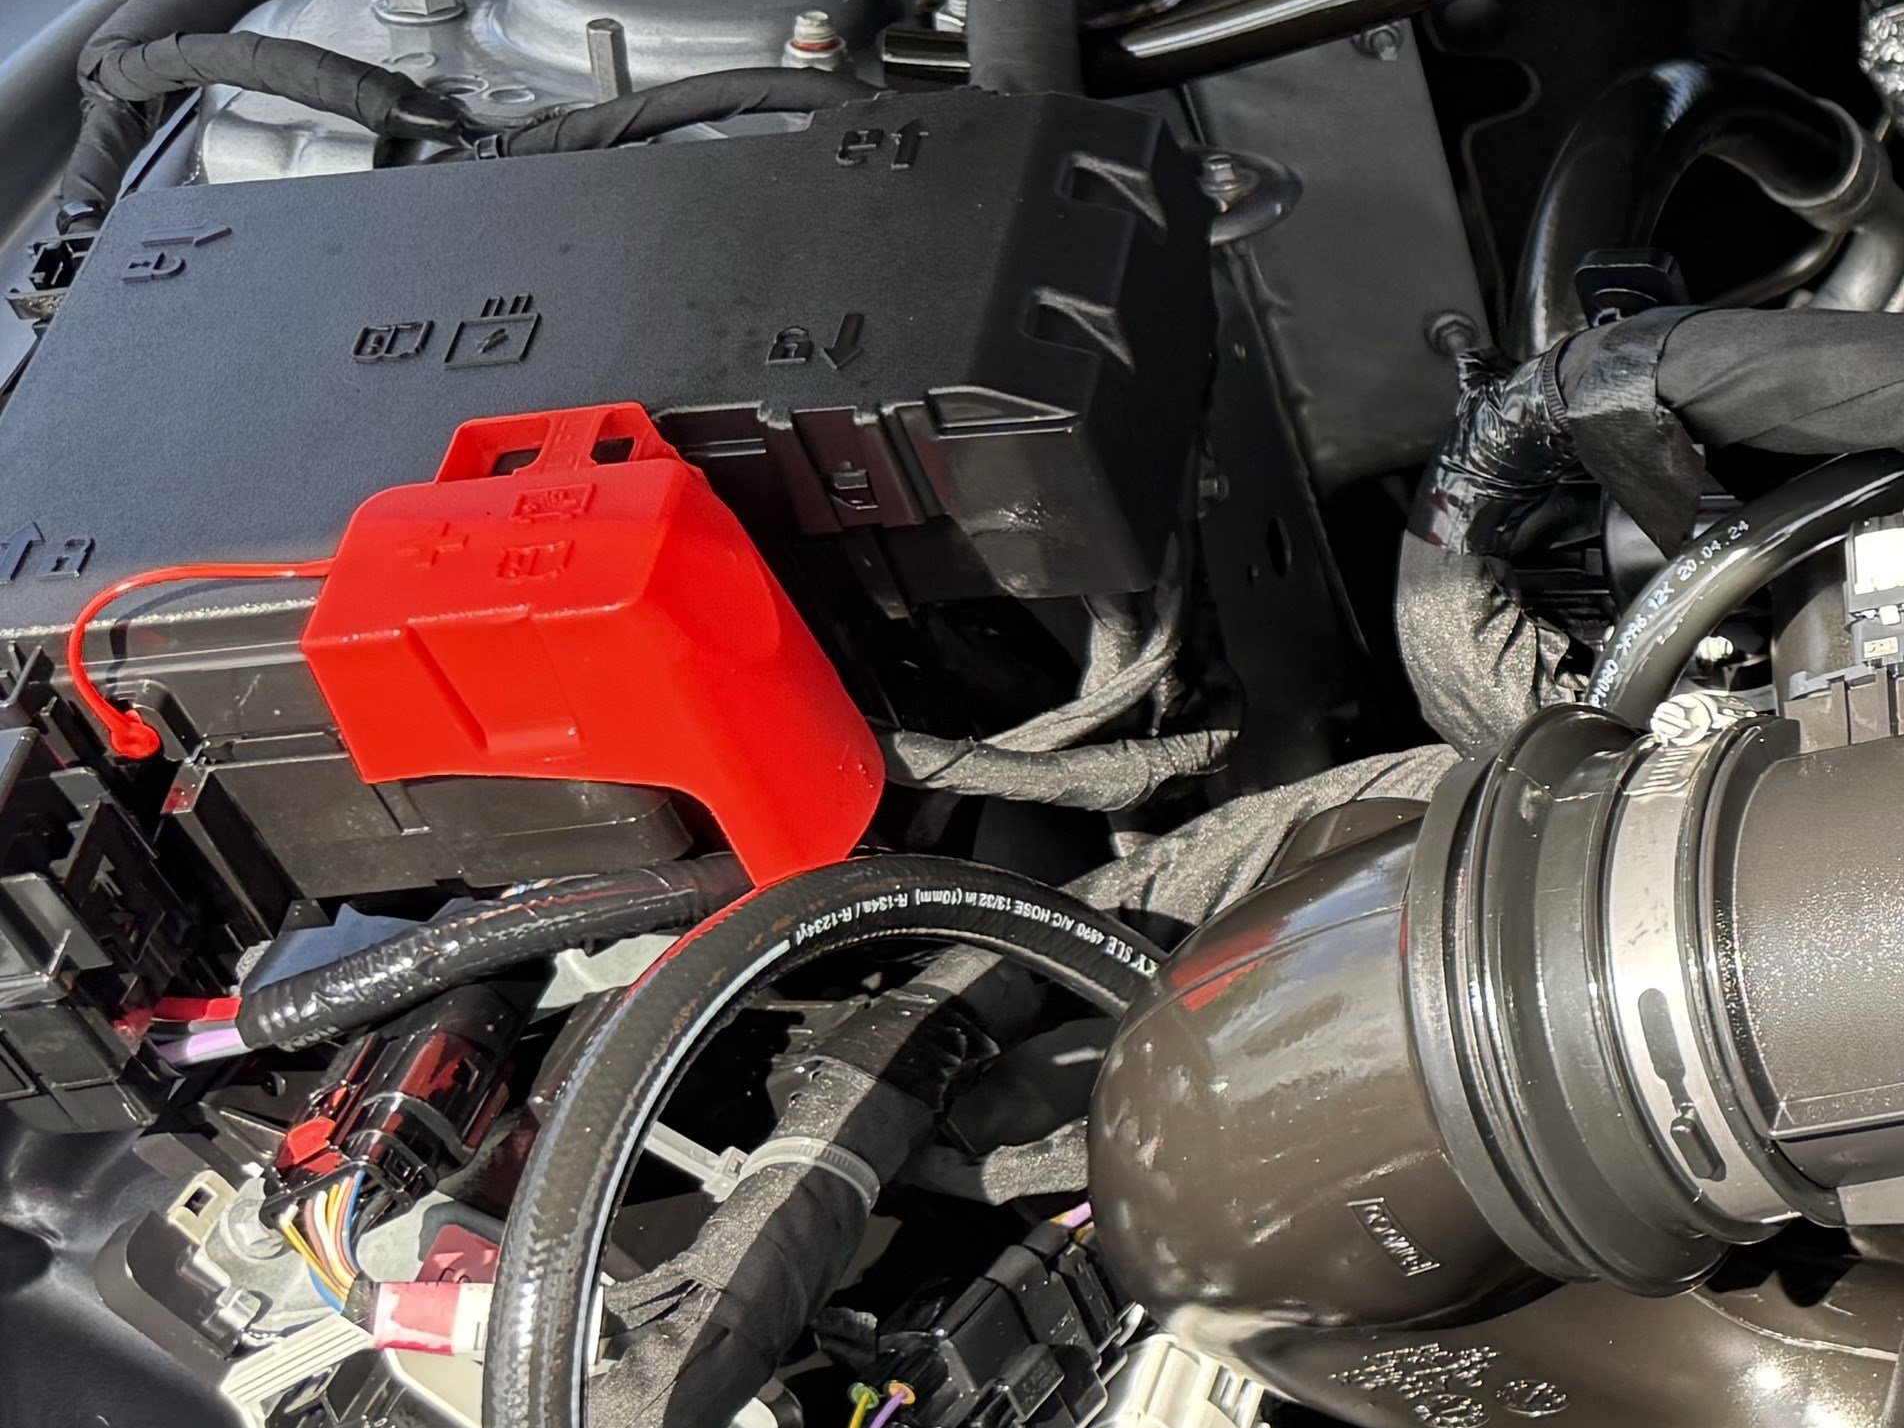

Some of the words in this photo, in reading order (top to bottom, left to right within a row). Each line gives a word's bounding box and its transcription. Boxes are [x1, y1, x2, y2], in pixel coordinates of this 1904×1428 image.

[1677, 519, 1750, 581] 20.04.24
[864, 892, 908, 914] R-134a
[916, 887, 961, 906] (10mm)
[962, 891, 977, 905] in
[977, 893, 1012, 912] 13/32
[1015, 902, 1050, 924] HOSE
[1053, 914, 1075, 932] A/C
[1105, 939, 1134, 967] SLE
